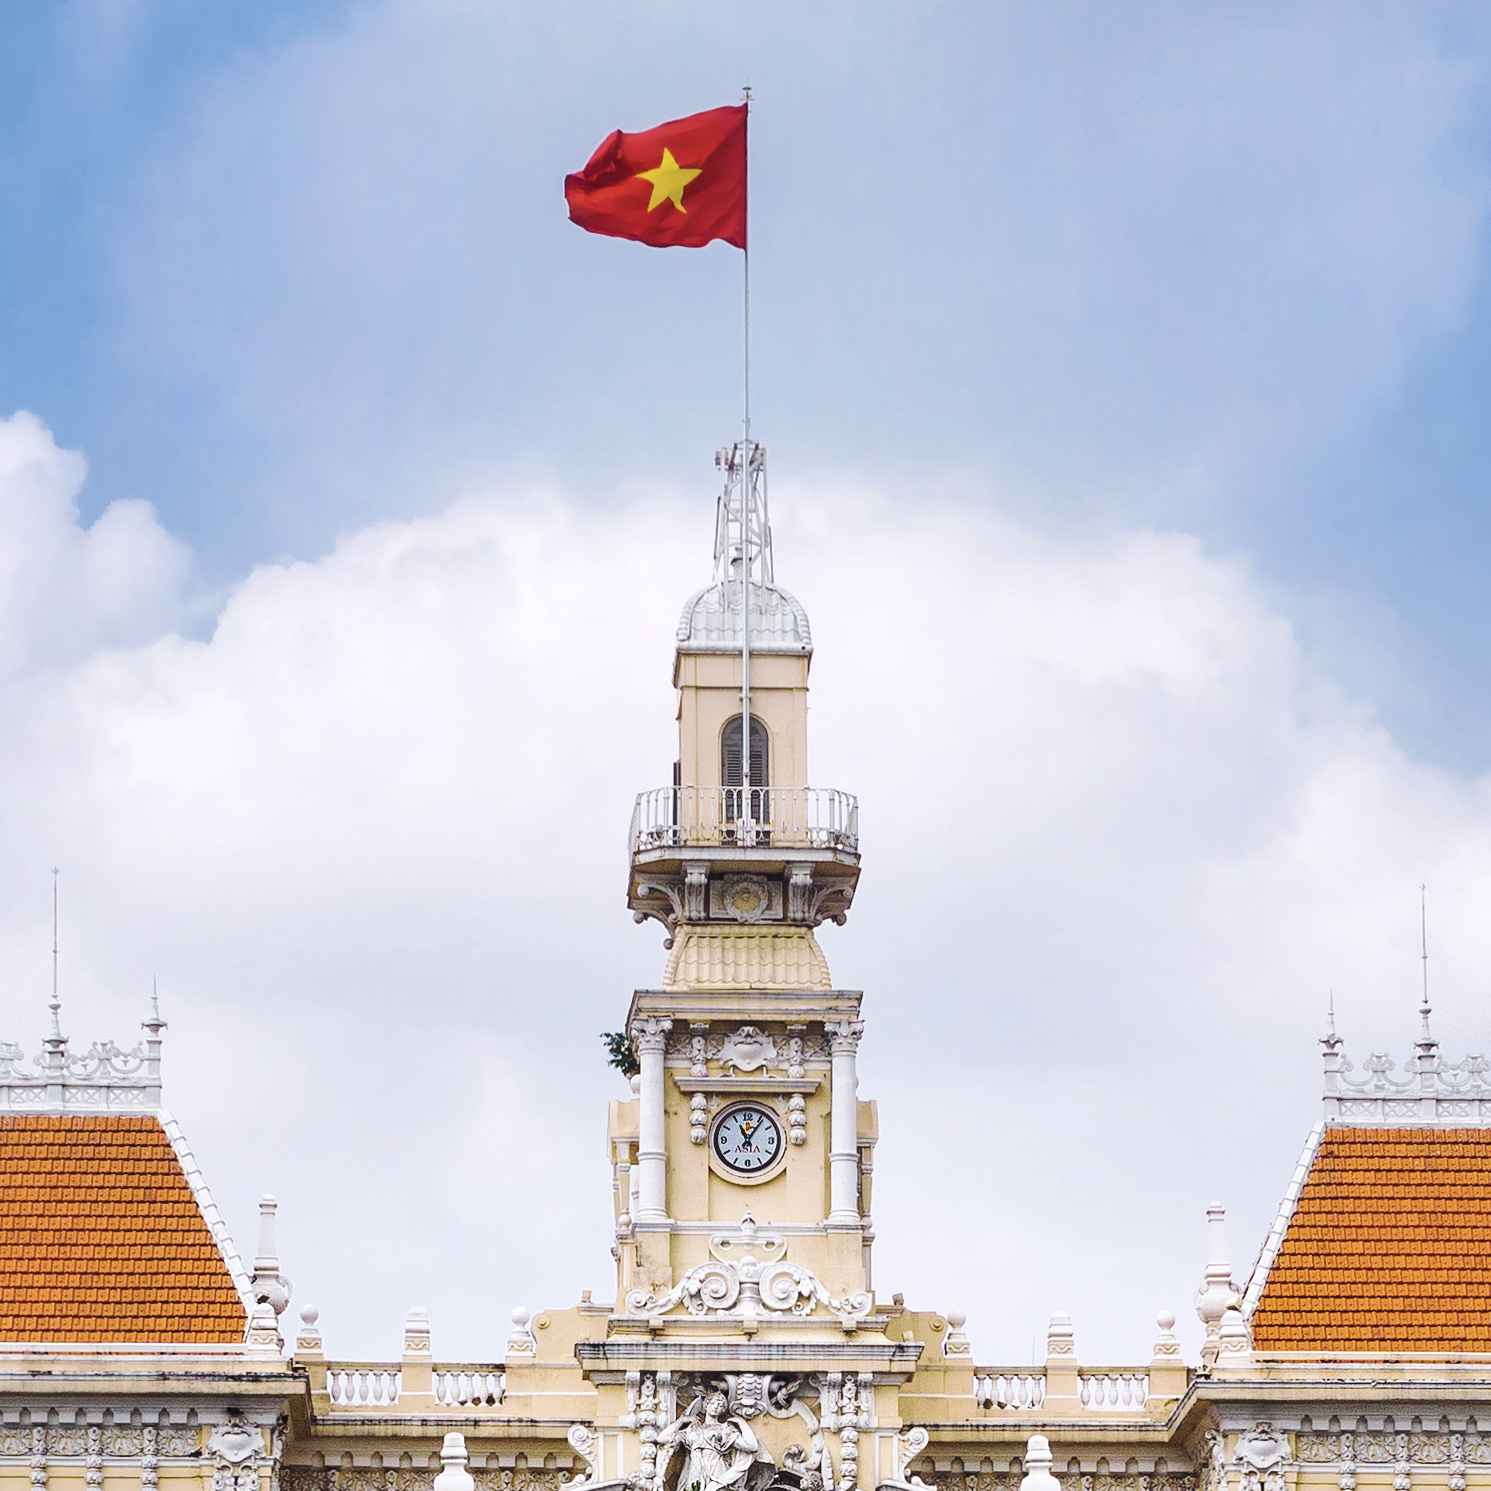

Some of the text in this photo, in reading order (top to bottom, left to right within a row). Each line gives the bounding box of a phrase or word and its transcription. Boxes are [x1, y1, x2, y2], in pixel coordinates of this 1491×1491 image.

[743, 1113, 753, 1121] 12
[721, 1136, 727, 1144] 9
[768, 1137, 774, 1145] 3
[735, 1145, 760, 1153] ASIA
[744, 1159, 751, 1167] 6
